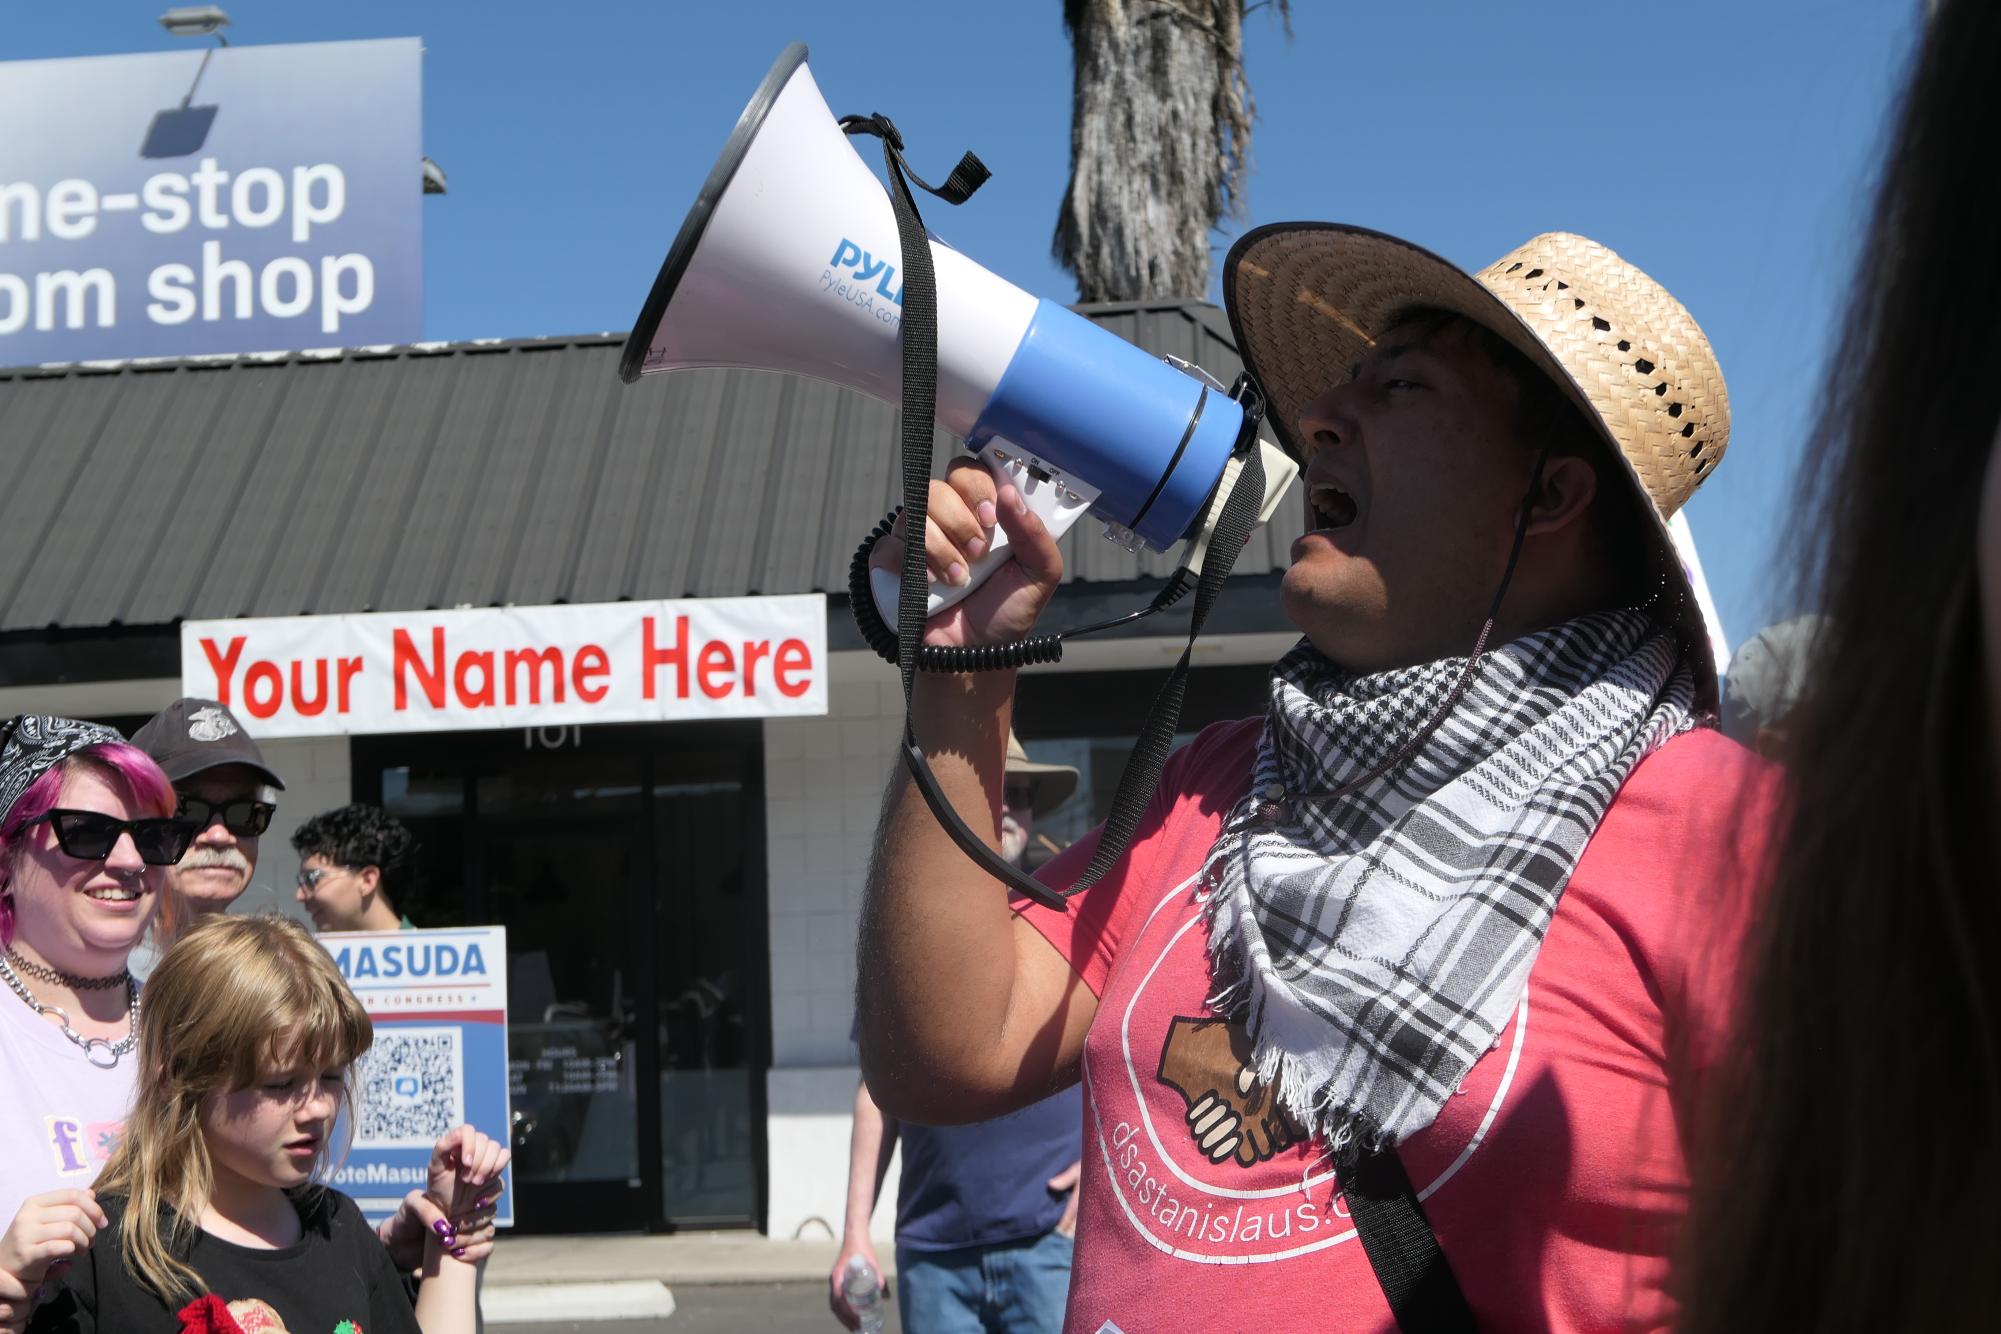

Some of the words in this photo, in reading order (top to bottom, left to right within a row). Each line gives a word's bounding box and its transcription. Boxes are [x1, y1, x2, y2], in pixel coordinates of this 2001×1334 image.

[146, 240, 375, 333] shop
[199, 636, 363, 719] Your
[393, 626, 612, 712] Name
[641, 615, 813, 701] Here
[318, 1163, 429, 1185] VoteMasu
